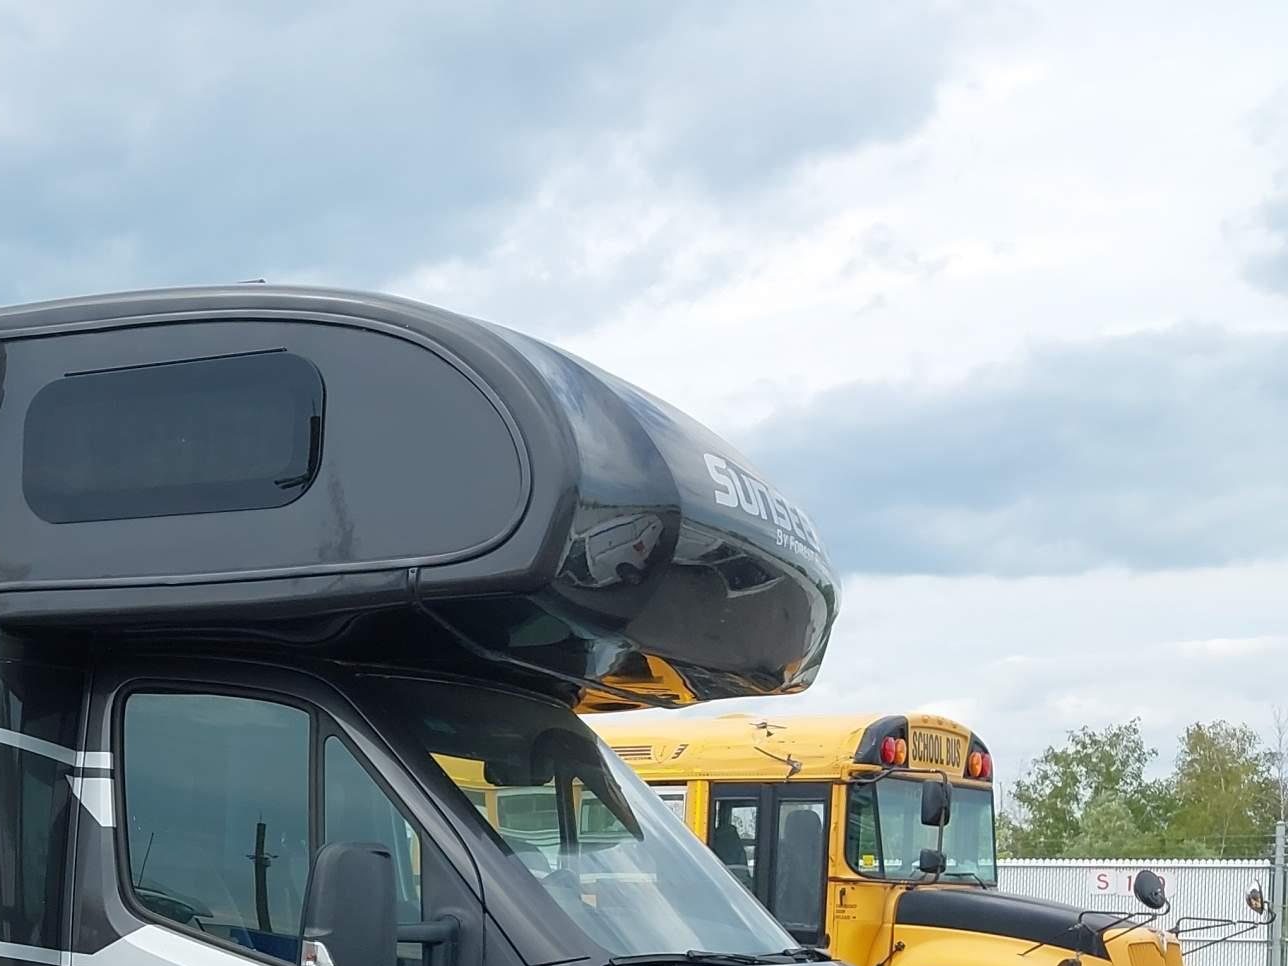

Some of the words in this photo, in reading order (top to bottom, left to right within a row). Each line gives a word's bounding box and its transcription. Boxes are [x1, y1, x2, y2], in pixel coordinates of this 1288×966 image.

[912, 730, 945, 765] SCHOOL
[946, 736, 961, 769] BUS
[1096, 873, 1110, 891] S
